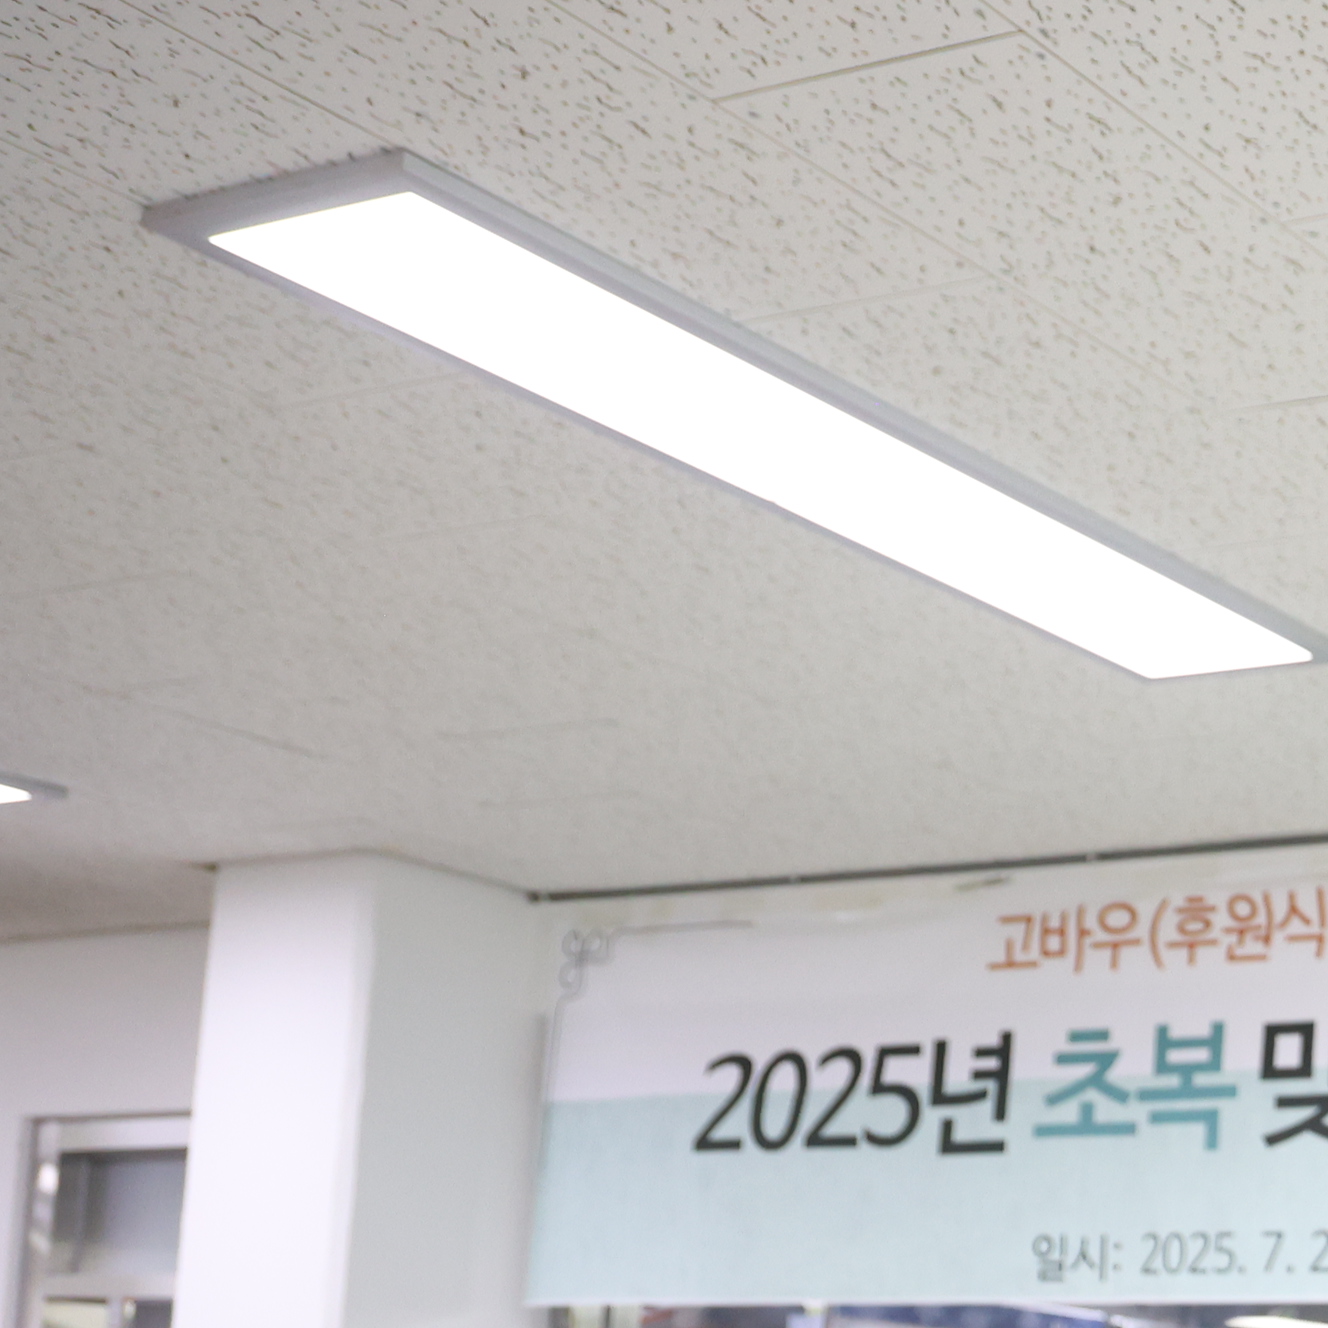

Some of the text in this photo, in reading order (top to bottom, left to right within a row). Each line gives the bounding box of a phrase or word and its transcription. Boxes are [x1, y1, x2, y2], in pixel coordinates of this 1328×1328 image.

[692, 1028, 1013, 1156] 2025년
[1031, 1022, 1238, 1150] 초복
[1031, 1233, 1122, 1284] 일시:
[1139, 1230, 1245, 1276] 2025.
[1261, 1229, 1295, 1274] 7.
